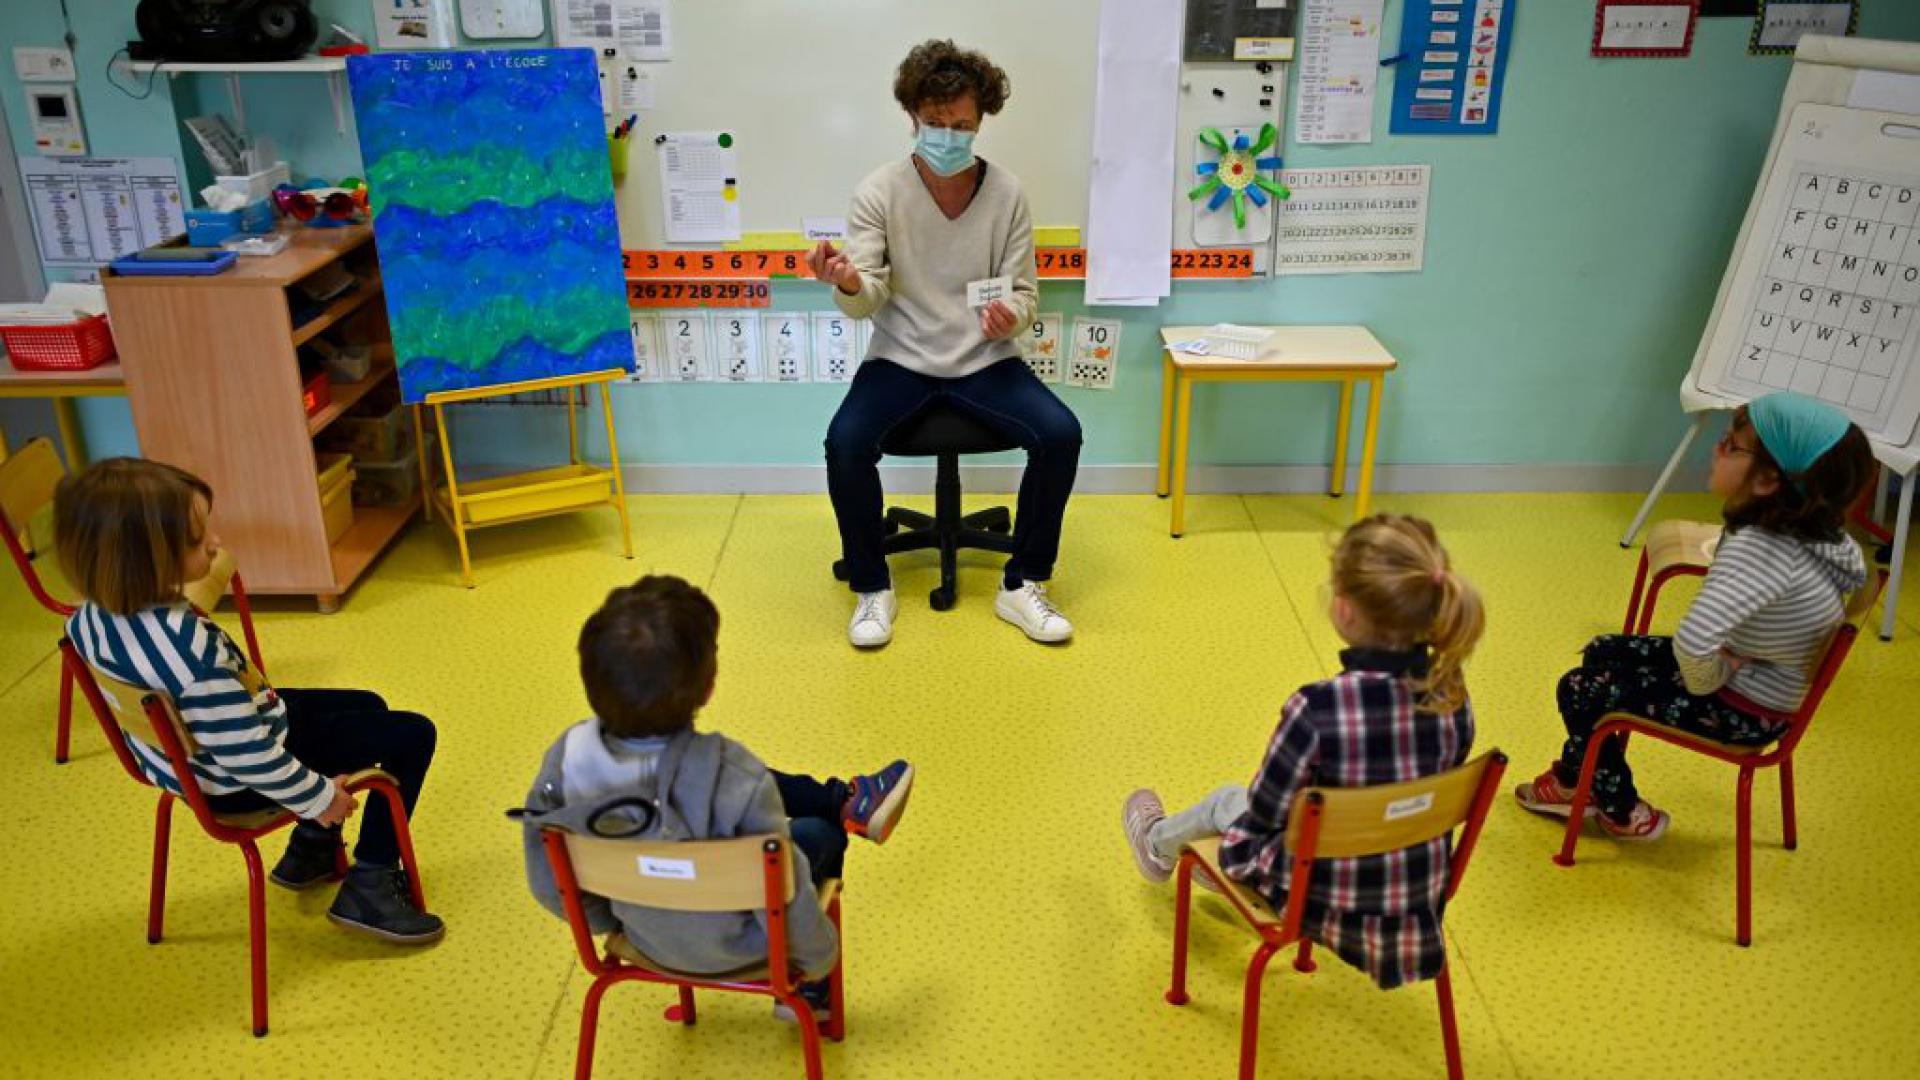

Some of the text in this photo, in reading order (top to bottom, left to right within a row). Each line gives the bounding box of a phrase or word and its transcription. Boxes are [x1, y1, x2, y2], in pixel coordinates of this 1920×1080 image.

[392, 59, 411, 72] JE
[427, 59, 453, 71] SUIS
[1806, 176, 1911, 203] A B C D
[1794, 211, 1896, 240] F G H I
[622, 254, 631, 269] 2
[647, 254, 658, 269] 3
[675, 254, 686, 269] 4
[703, 254, 713, 269] 5
[731, 254, 742, 269] 6
[757, 254, 768, 269] 7
[785, 254, 796, 269] 8
[1060, 254, 1081, 268] 18
[1172, 254, 1195, 268] 22
[1200, 254, 1223, 268] 23
[1228, 254, 1250, 268] 24
[1782, 244, 1918, 282] K L M N O
[633, 284, 768, 299] 26 27 28 29 30
[1770, 282, 1902, 318] P Q R S T
[631, 322, 639, 336] 1
[679, 320, 690, 336] 2
[730, 320, 741, 336] 3
[780, 322, 792, 336] 4
[831, 320, 842, 336] 5
[1033, 321, 1044, 338] 9
[1087, 325, 1107, 344] 10
[1760, 314, 1891, 353] U V W X Y
[1748, 345, 1762, 360] Z
